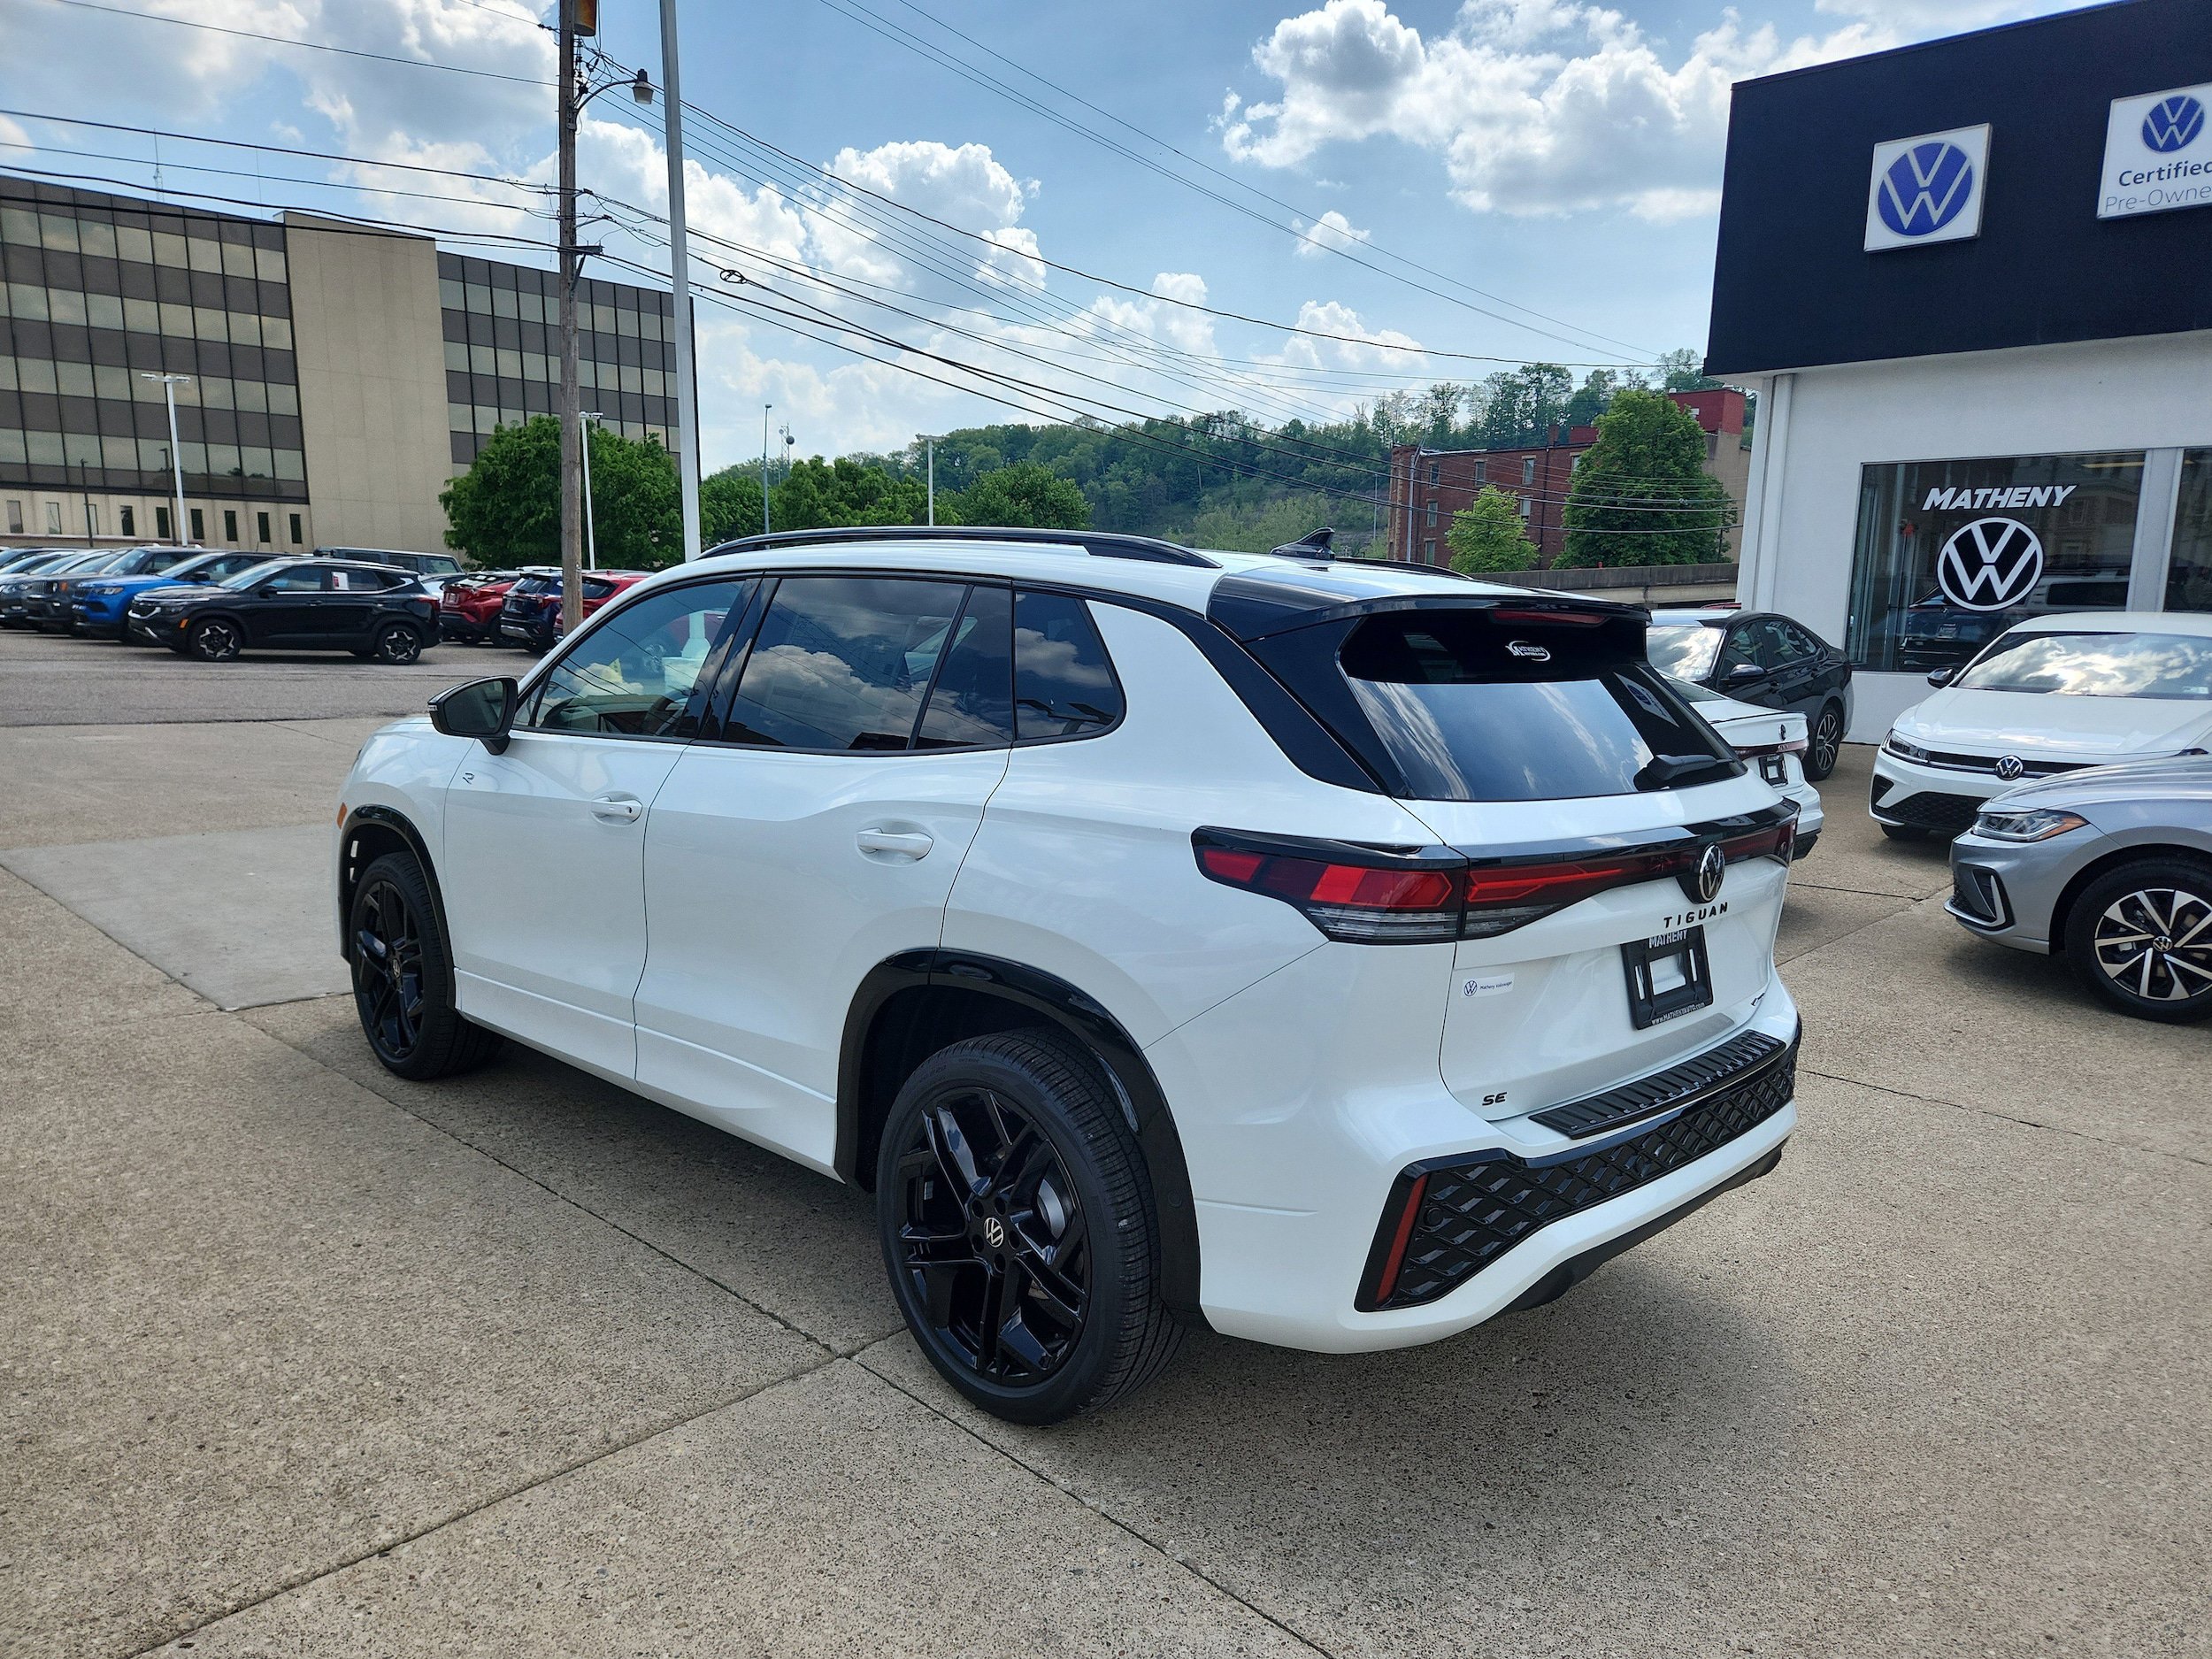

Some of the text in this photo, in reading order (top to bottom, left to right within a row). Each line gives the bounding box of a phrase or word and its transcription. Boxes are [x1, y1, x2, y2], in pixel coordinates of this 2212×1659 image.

[2104, 185, 2212, 212] Pre-Owne
[1921, 485, 2078, 511] MATHENY
[1937, 517, 2044, 611] VW
[1663, 901, 1728, 929] TIGUAN
[1647, 929, 1689, 949] MATHENY
[1481, 1091, 1508, 1106] SE
